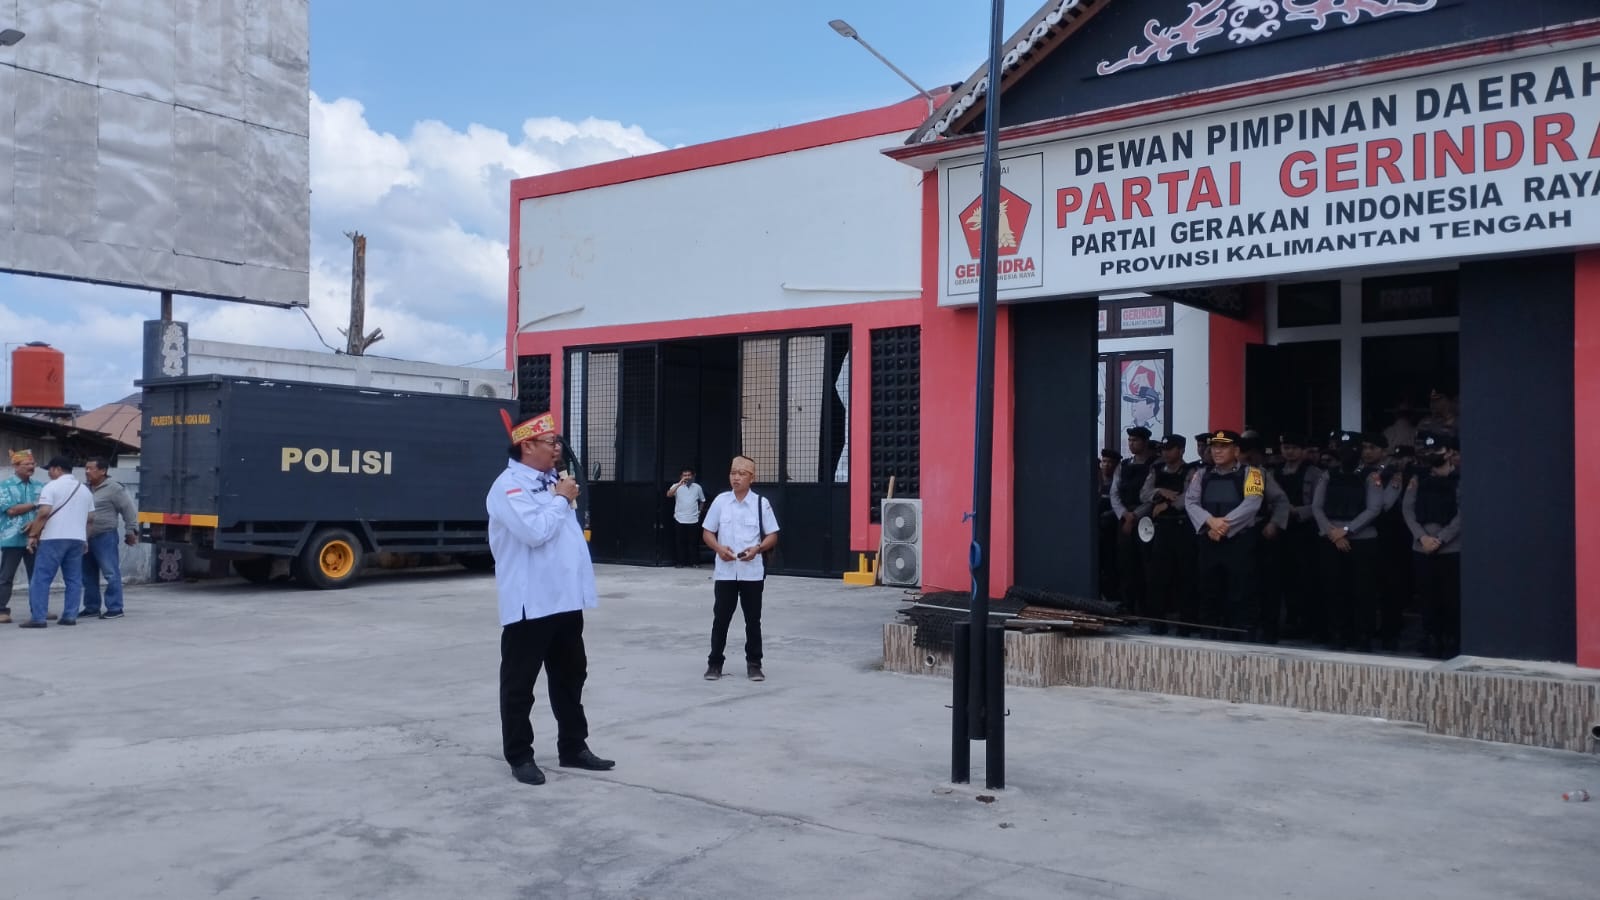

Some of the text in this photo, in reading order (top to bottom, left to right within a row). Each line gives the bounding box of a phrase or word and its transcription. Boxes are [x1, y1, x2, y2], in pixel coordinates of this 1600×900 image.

[1074, 129, 1193, 176] DEWAN
[1207, 94, 1397, 155] PIMPINAN
[1056, 161, 1242, 229] PARTAI
[1071, 226, 1156, 256] PARTAI
[1170, 206, 1309, 244] GERAKAN
[1325, 182, 1503, 226] INDONESIA
[1100, 209, 1572, 276] PROVINSI KALIMANTAN TENGAH
[954, 278, 979, 286] GERAKA
[281, 447, 392, 475] POLISI
